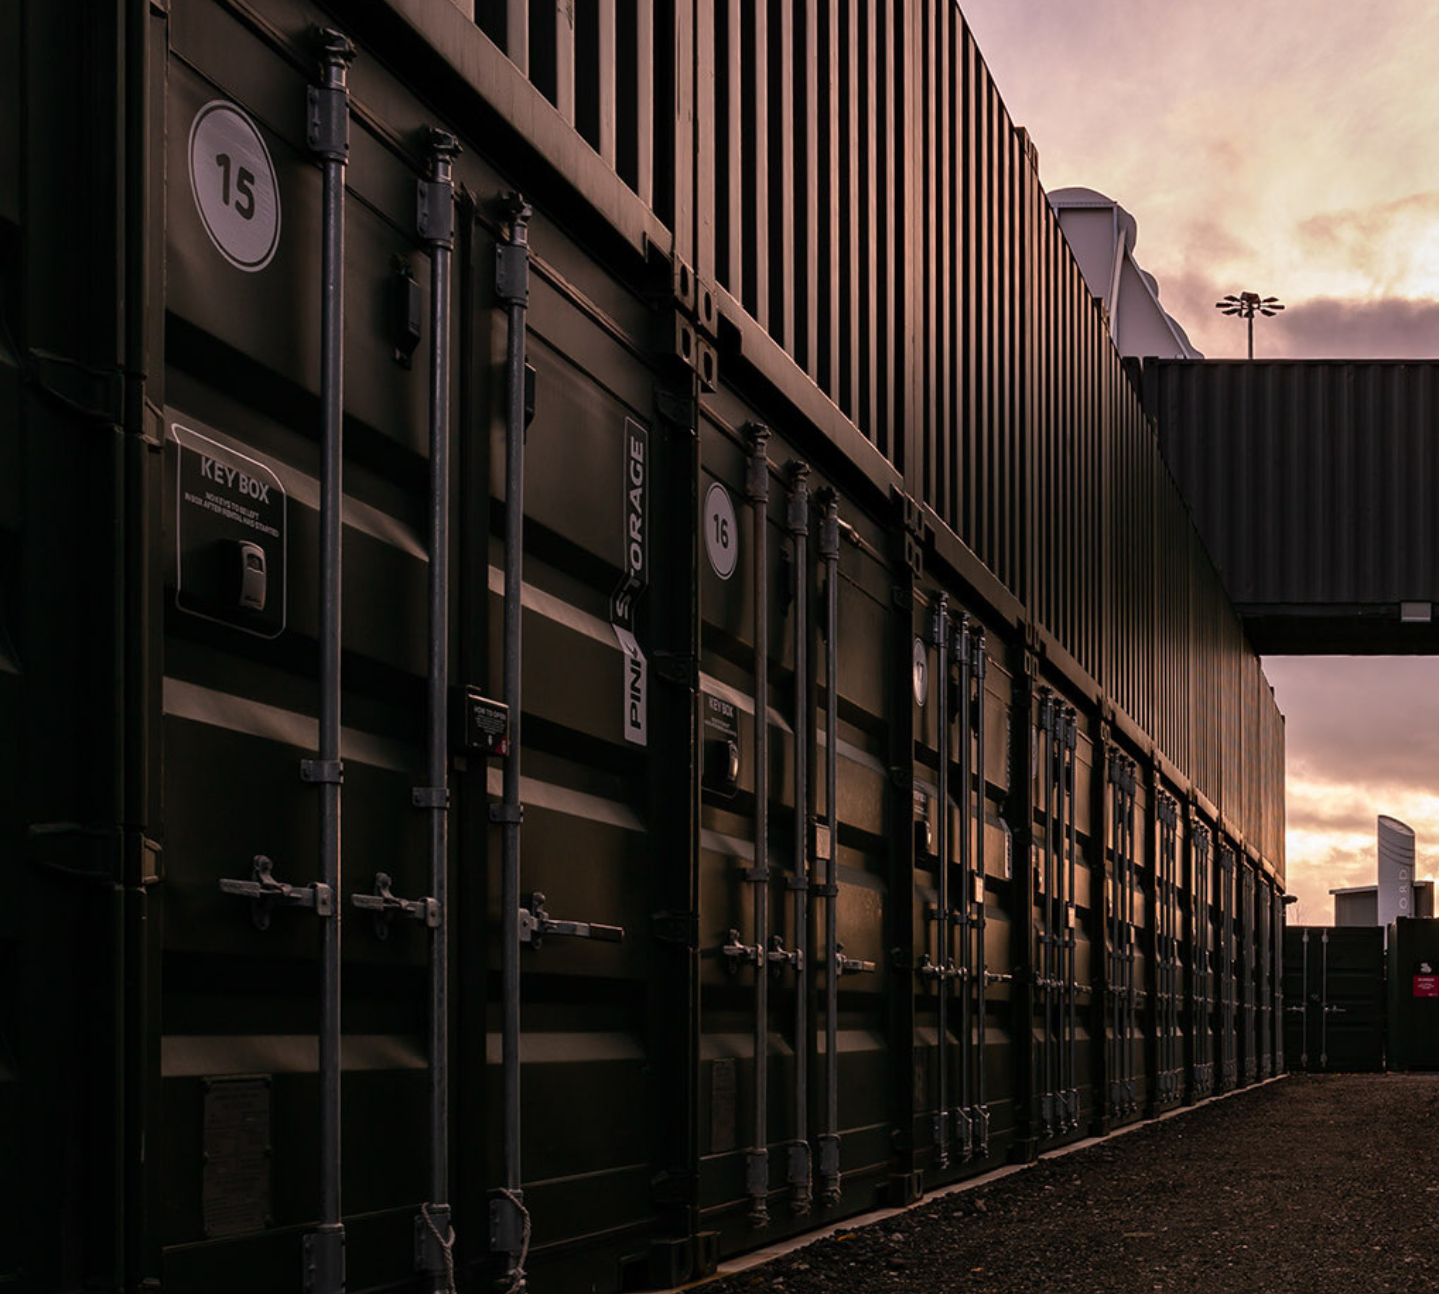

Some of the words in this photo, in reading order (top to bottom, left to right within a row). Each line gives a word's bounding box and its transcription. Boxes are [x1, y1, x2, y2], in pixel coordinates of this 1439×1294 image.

[216, 153, 255, 221] 15
[201, 456, 236, 488] KEY
[239, 472, 270, 505] BOX
[616, 436, 644, 621] STORAGE
[713, 513, 728, 549] 16
[625, 641, 642, 729] PINK
[709, 696, 721, 713] KEY
[721, 702, 735, 718] BOX
